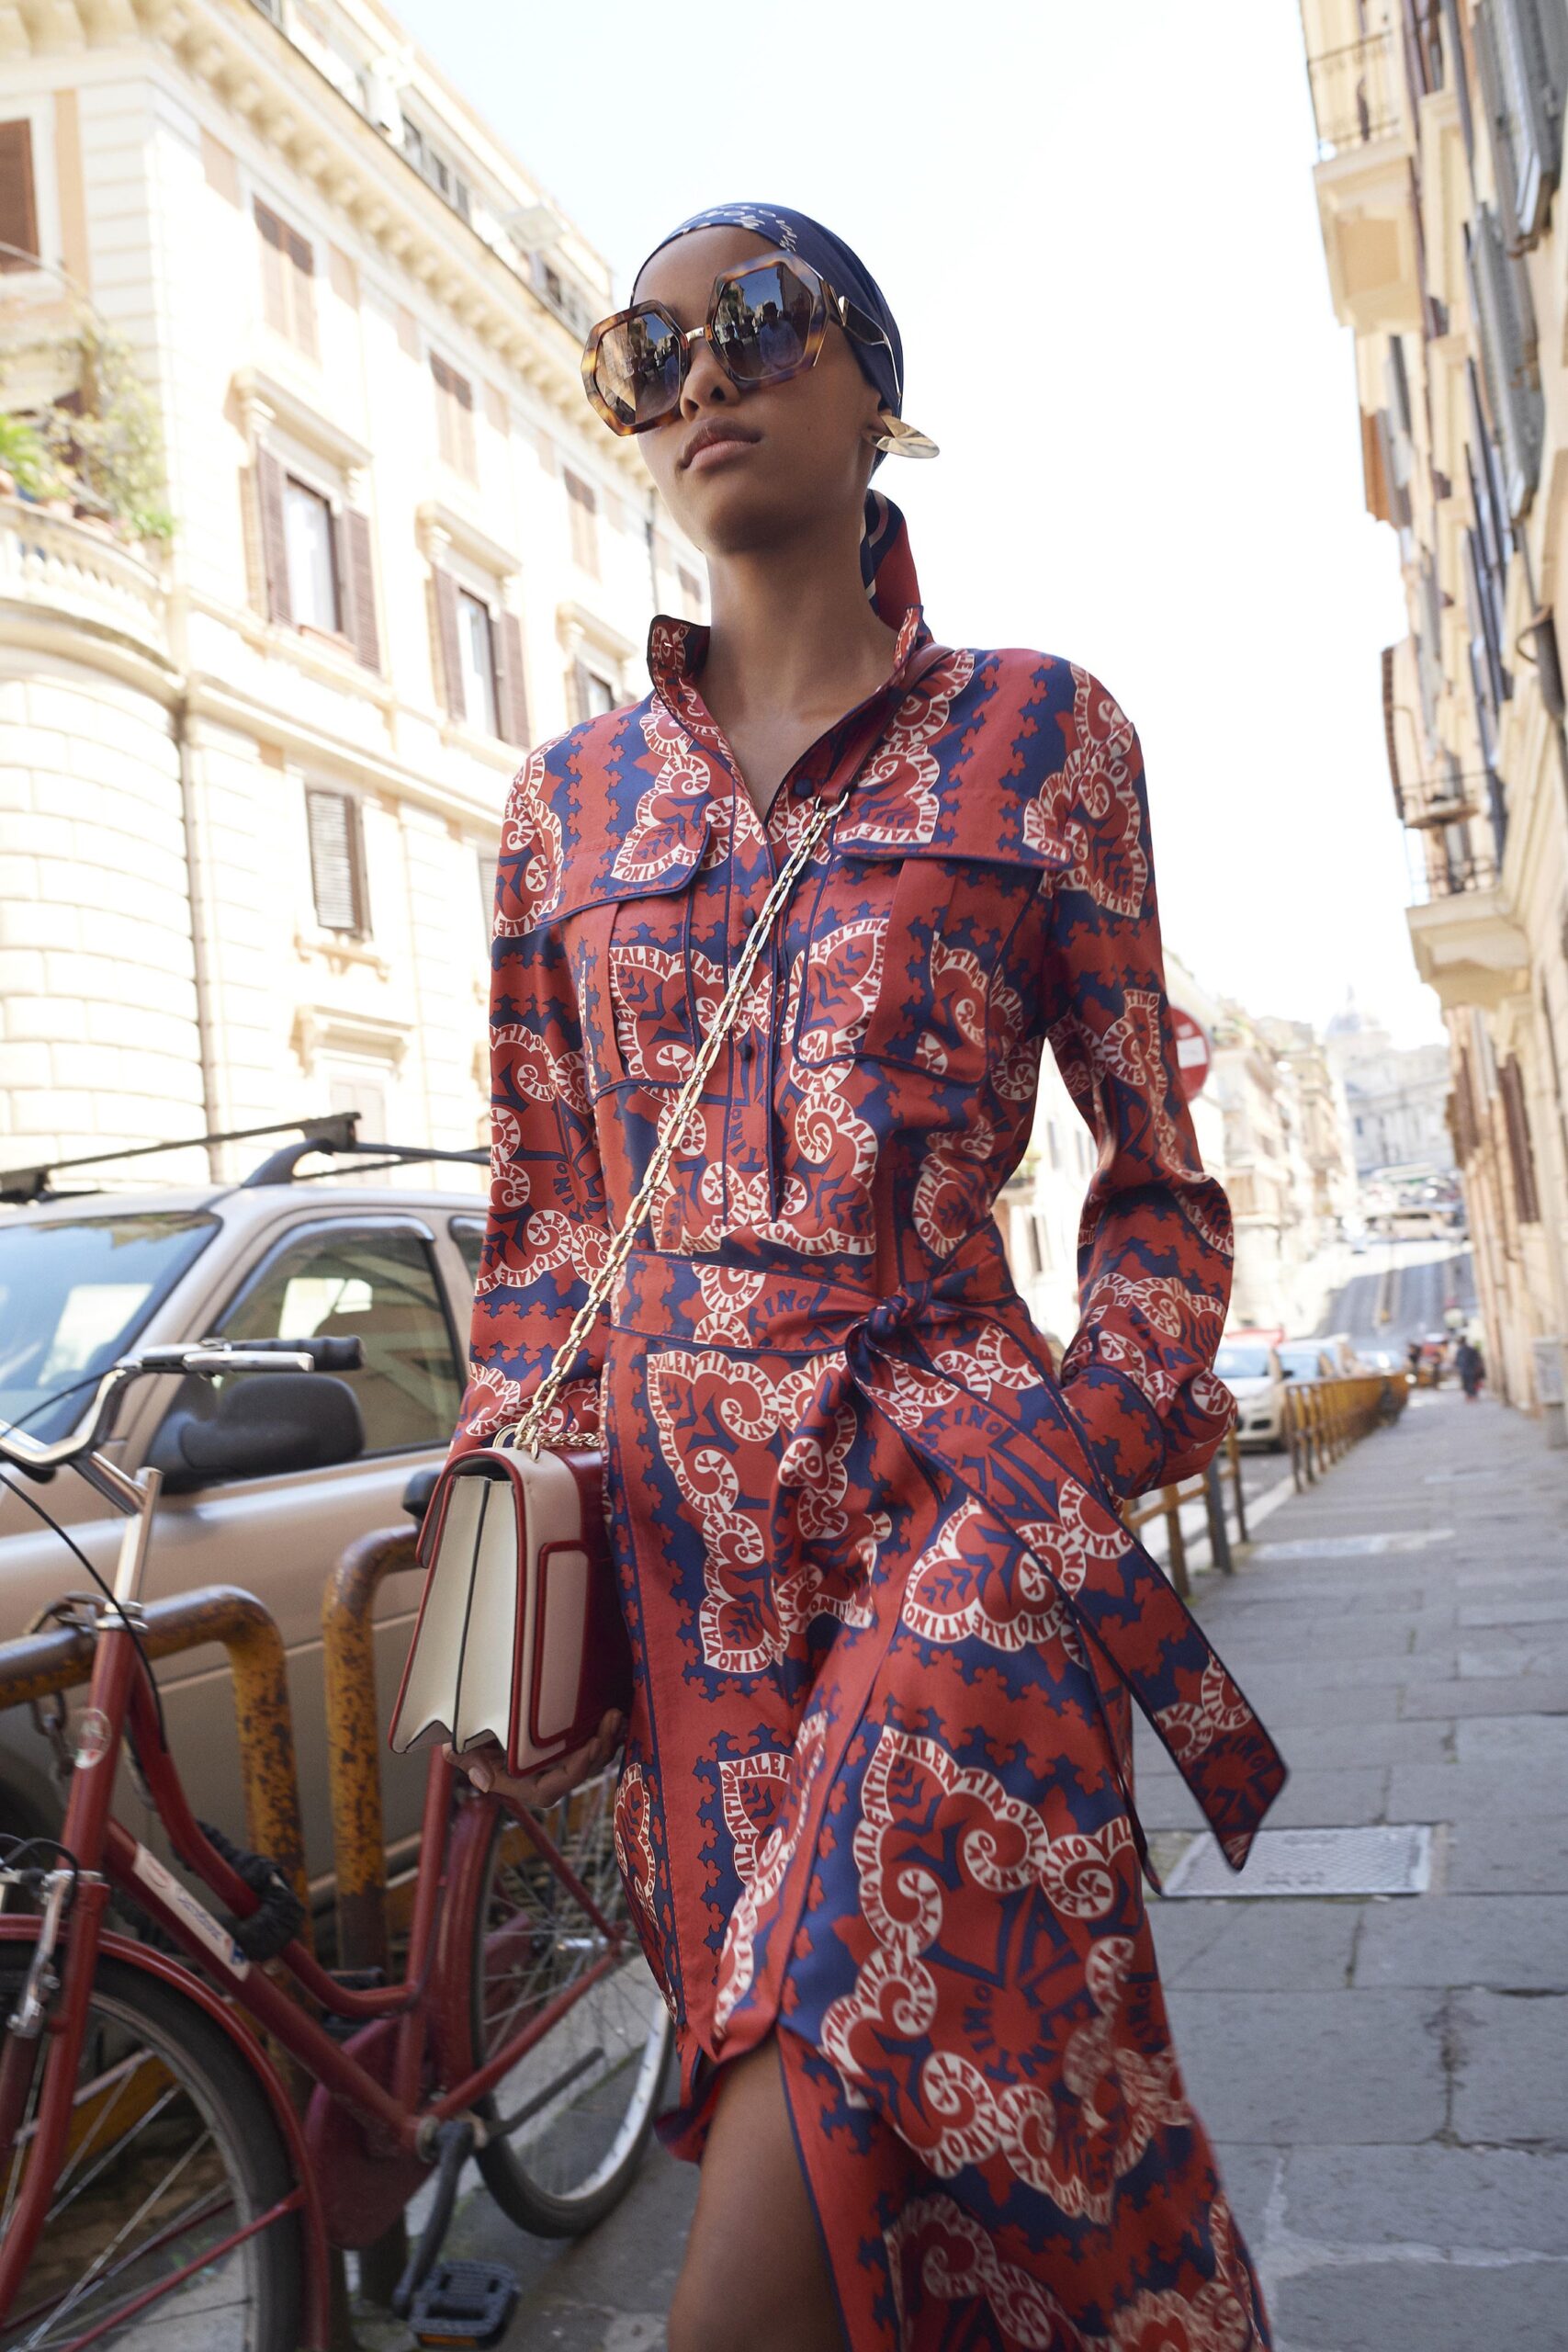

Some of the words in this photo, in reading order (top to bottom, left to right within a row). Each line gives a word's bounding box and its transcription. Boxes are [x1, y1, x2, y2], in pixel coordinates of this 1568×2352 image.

[653, 1351, 744, 1380] VALENTINO
[723, 1365, 778, 1440] VALENTINO
[676, 1450, 737, 1513] VALENTINO
[904, 1602, 1021, 1647] VALENTINO
[888, 1730, 1020, 1817] VALENTINO
